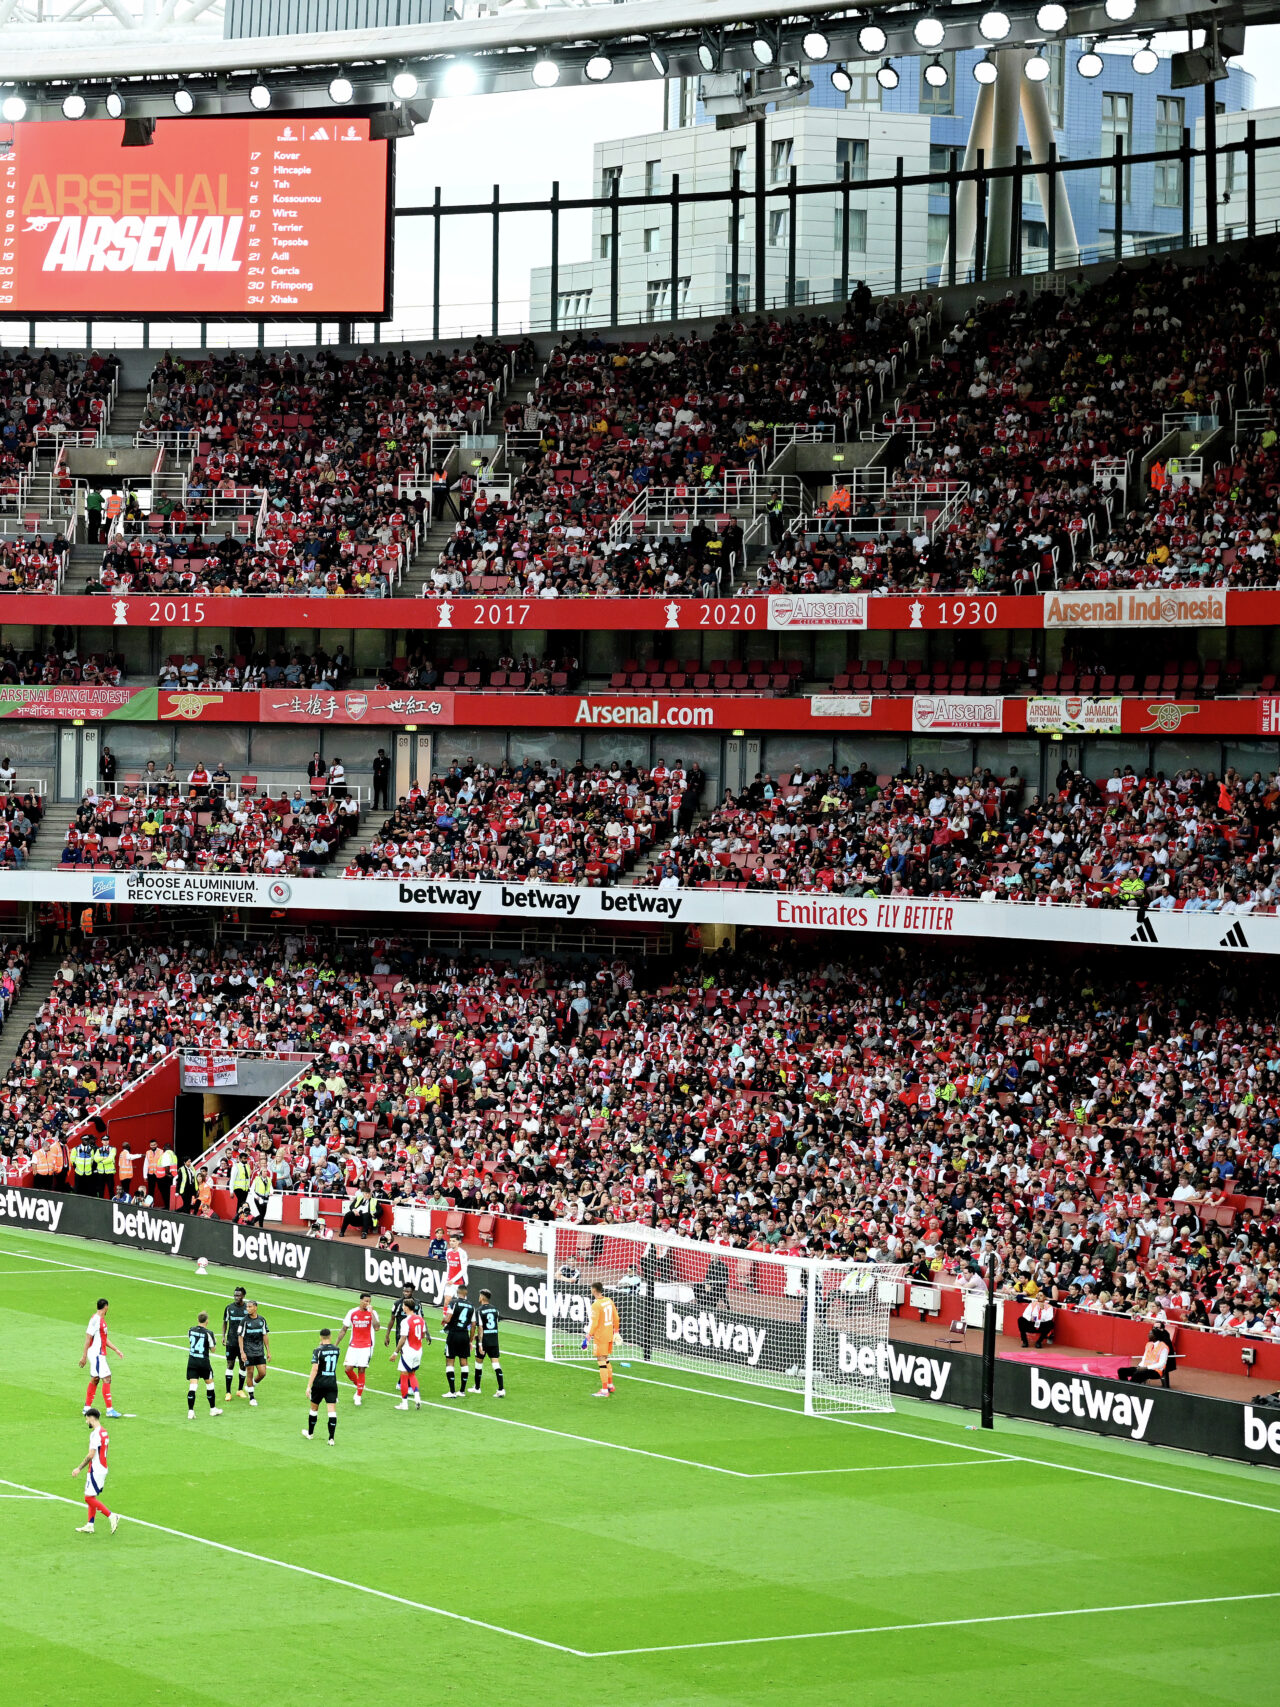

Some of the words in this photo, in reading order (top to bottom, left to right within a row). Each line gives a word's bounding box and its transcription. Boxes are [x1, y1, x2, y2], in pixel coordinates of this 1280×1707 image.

[0, 153, 16, 161] 22
[250, 152, 261, 160] 17
[274, 151, 300, 160] Kovar
[6, 167, 16, 175] 2
[250, 166, 259, 175] 3
[274, 166, 312, 176] Hincapie
[250, 181, 258, 189] 4
[273, 180, 290, 188] Tah
[21, 173, 243, 216] ARSENAL
[273, 194, 322, 203] Kossounou
[6, 210, 15, 218] 8
[249, 210, 261, 218] 10
[272, 209, 298, 217] Wirtz
[6, 224, 15, 232] 9
[249, 224, 256, 232] 11
[272, 223, 304, 232] Terrier
[4, 238, 15, 246] 17
[42, 215, 244, 272] ARSENAL
[249, 238, 261, 246] 12
[272, 237, 309, 248] Tapsoba
[248, 252, 261, 261] 21
[271, 252, 289, 260] Adli
[248, 267, 265, 275] 24
[271, 266, 300, 275] Garcia
[1, 281, 13, 289] 21
[271, 280, 313, 291] Frimpong
[247, 296, 264, 304] 34
[270, 295, 298, 304] Xhaka
[149, 602, 205, 623] 2015
[474, 604, 530, 625] 2017
[700, 604, 756, 625] 2020
[792, 597, 864, 618] Arsenal
[938, 602, 997, 625] 1930
[1047, 595, 1123, 623] Arsenal
[1128, 594, 1224, 623] Indonesia
[0, 688, 52, 702] ARSENAL
[54, 688, 130, 704] BANGLADESH
[272, 693, 340, 720] 一生槍手
[371, 695, 443, 716] 一世紅白
[574, 700, 714, 726] Arsenal.com
[934, 698, 1001, 721] Arsenal
[1029, 704, 1062, 716] ARSENAL
[1084, 705, 1119, 717] JAMAICA
[1262, 699, 1270, 715] LIFE
[1262, 716, 1270, 732] ONE
[127, 877, 181, 889] CHOOSE
[184, 878, 259, 891] ALUMINIUM.
[128, 889, 194, 901] RECYCLES
[197, 891, 257, 903] FOREVER.
[399, 883, 482, 911] betway
[501, 886, 581, 915] betway
[601, 891, 683, 919] betway
[776, 899, 869, 927] Emirates
[876, 904, 901, 930] FLY
[903, 905, 954, 931] BETTER
[112, 1203, 185, 1254] betway
[232, 1224, 311, 1279] betway
[365, 1249, 447, 1304] betway
[458, 1308, 469, 1323] 4
[486, 1313, 496, 1329] 3
[666, 1303, 766, 1365] betway
[190, 1336, 205, 1354] 24
[324, 1355, 337, 1372] 11
[838, 1333, 952, 1399] betway
[1031, 1367, 1154, 1439] betway
